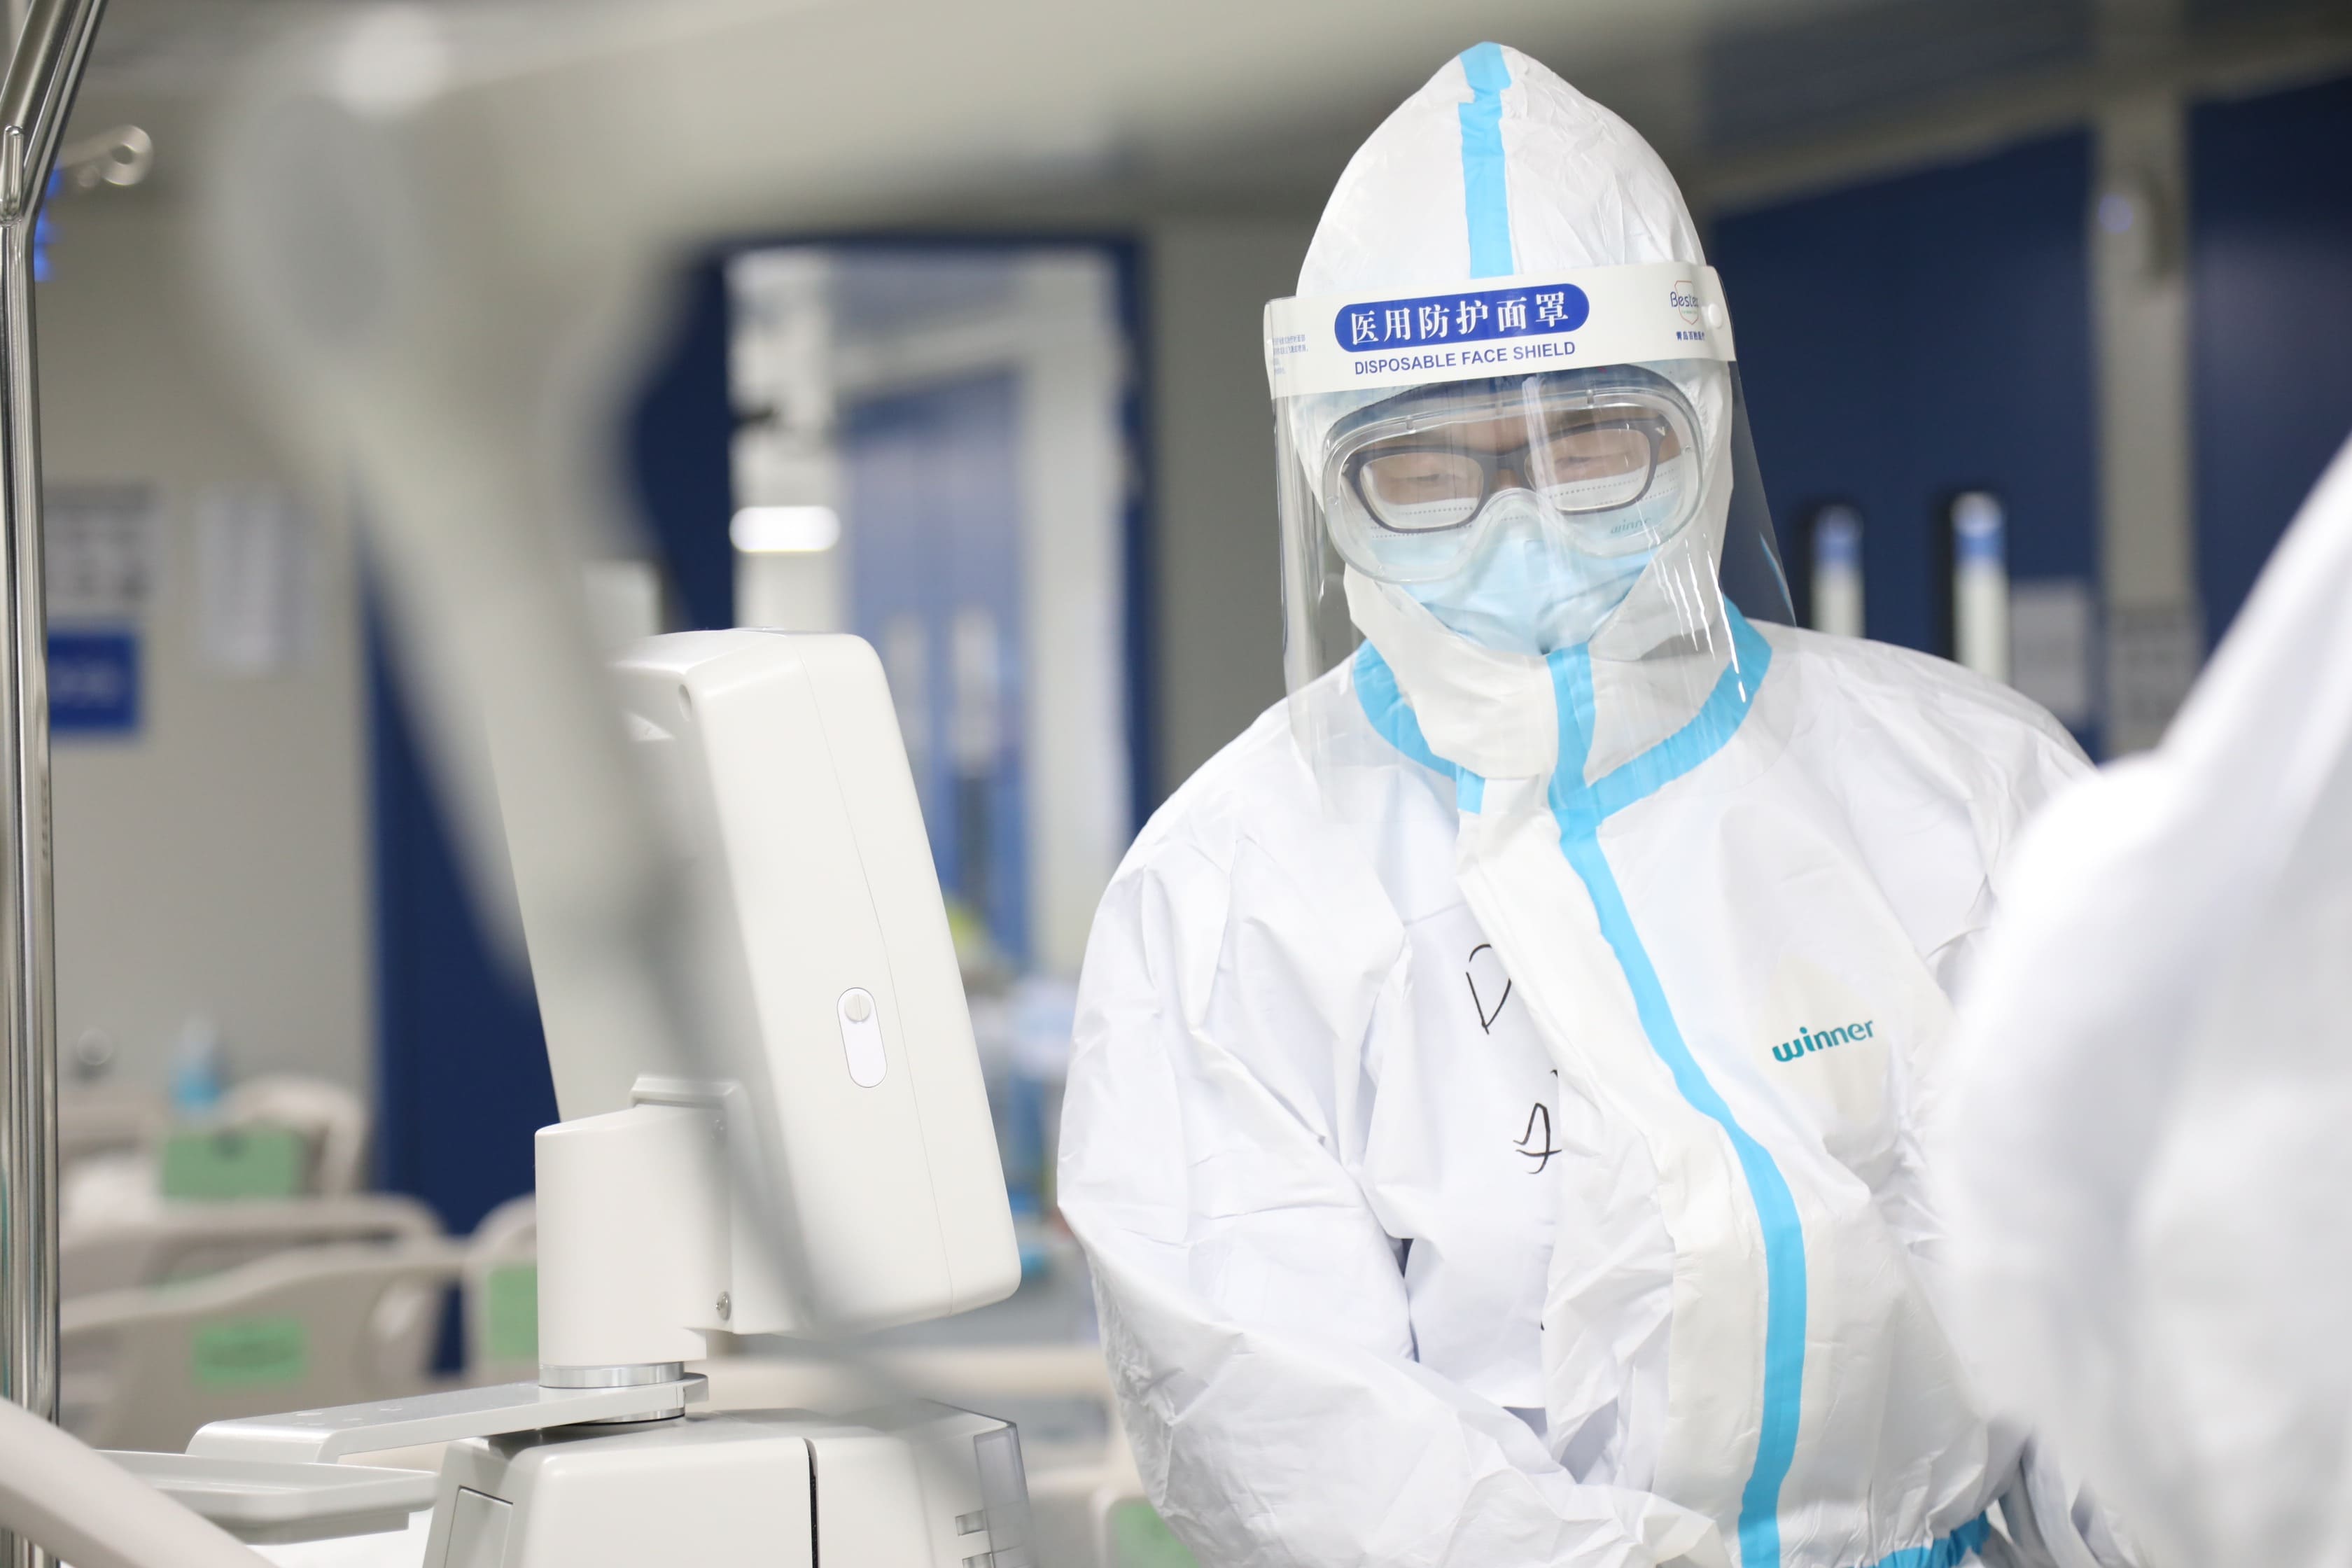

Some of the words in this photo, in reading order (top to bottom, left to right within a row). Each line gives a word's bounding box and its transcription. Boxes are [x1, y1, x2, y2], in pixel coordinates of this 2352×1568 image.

[1352, 291, 1569, 346] 医用防护面罩
[1354, 353, 1457, 375] DISPOSABLE
[1462, 349, 1508, 365] FACE
[1513, 342, 1576, 360] SHIELD
[1772, 1020, 1874, 1063] winner
